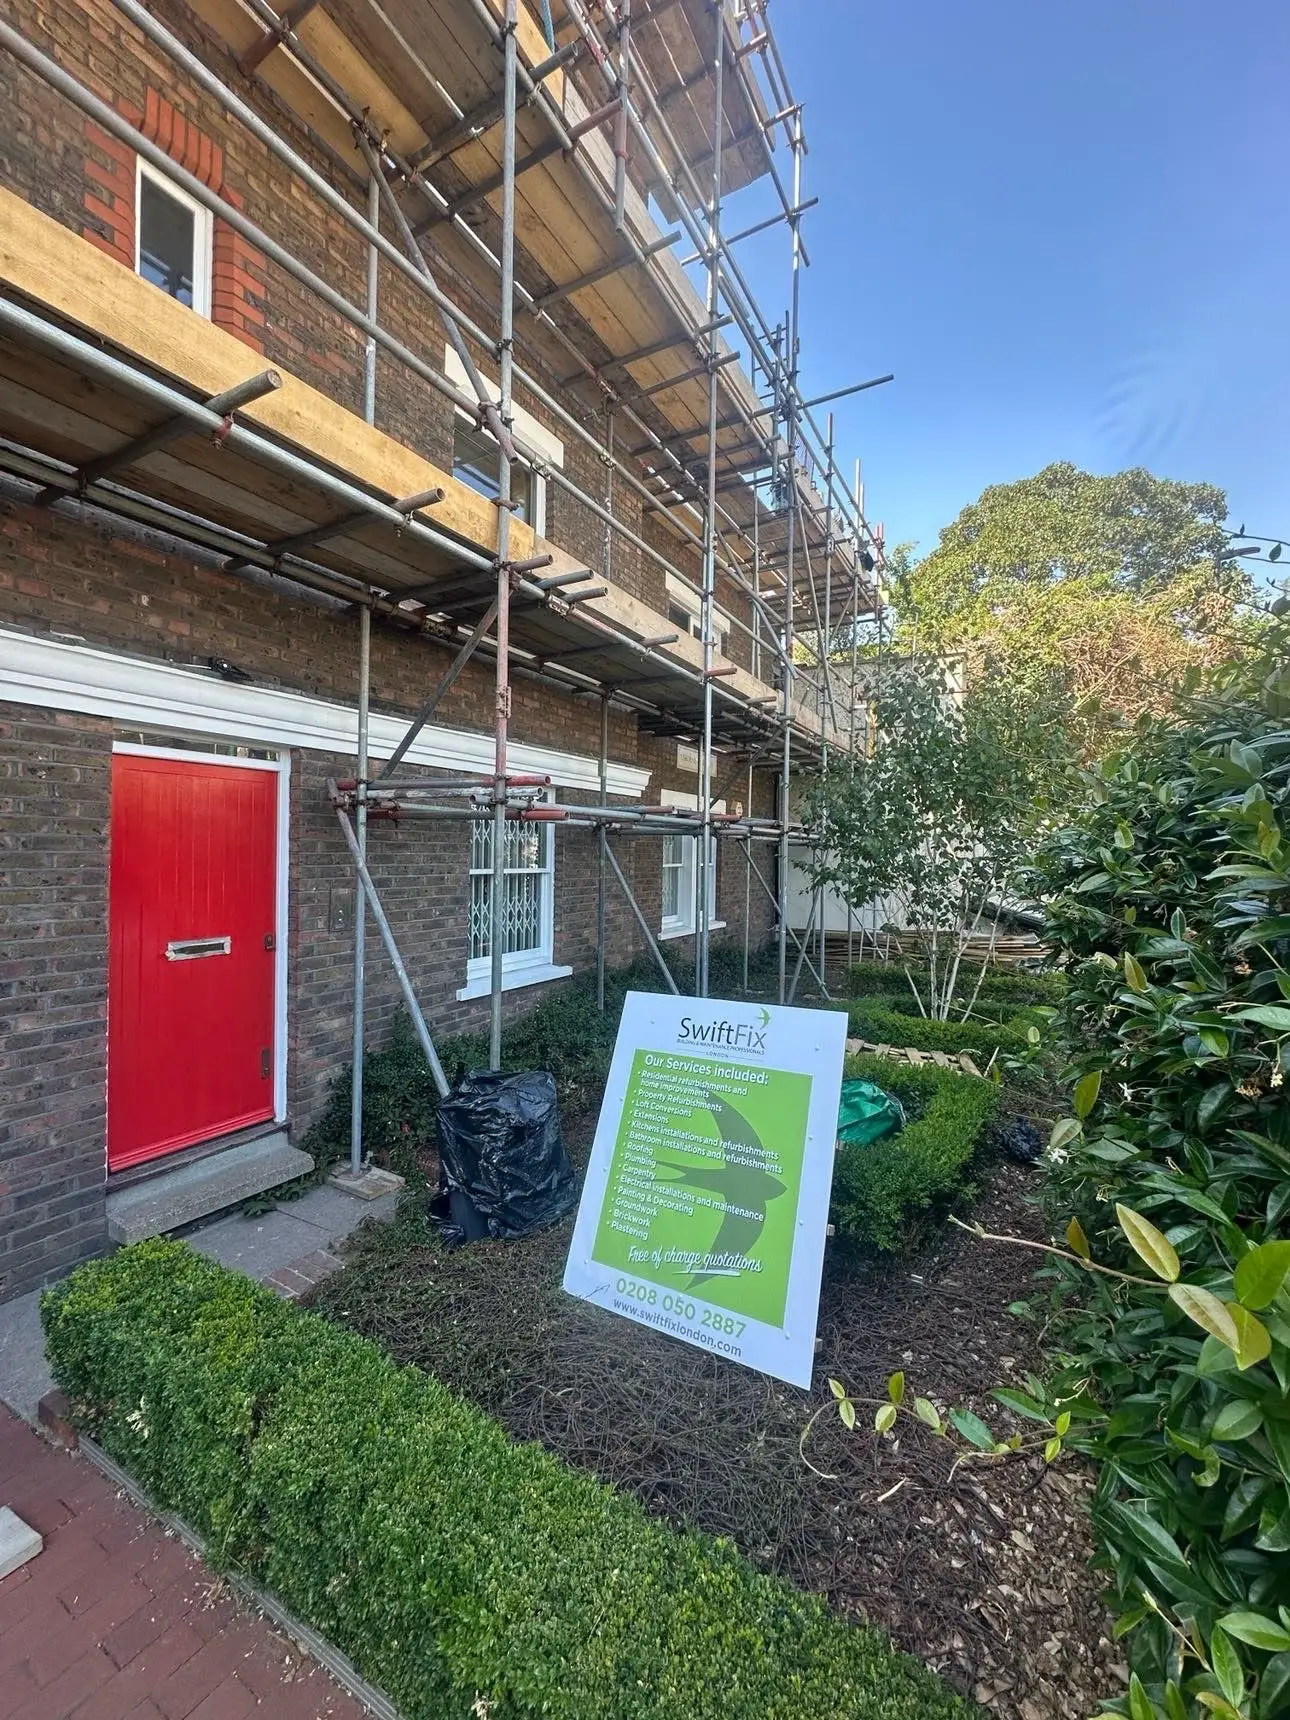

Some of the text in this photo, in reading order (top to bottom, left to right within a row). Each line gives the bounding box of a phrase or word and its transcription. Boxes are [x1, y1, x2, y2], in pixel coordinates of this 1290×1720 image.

[678, 1017, 767, 1049] SwiftFix
[645, 1054, 769, 1084] Our Services included:
[640, 1079, 710, 1099] home improvements
[641, 1070, 748, 1096] Residential refurbishments and
[636, 1099, 692, 1117] Loft Conversions
[638, 1089, 722, 1112] Property Refurbishments
[633, 1110, 669, 1124] Extensions
[627, 1141, 653, 1156] Roofing
[629, 1130, 783, 1174] Bathroom installations and refurbishments
[631, 1120, 779, 1160] Kitchens installations and refurbishments
[623, 1163, 657, 1180] Carpentry
[624, 1152, 657, 1168] Plumbing
[615, 1196, 658, 1216] Groundwork
[618, 1185, 694, 1216] Painting & Decorating
[620, 1174, 764, 1221] Electrical installations and maintenance
[613, 1208, 651, 1227] Brickwork
[611, 1220, 649, 1240] Plastering
[628, 1245, 763, 1273] Free of charge quotations
[615, 1278, 747, 1339] 0208 050 2887
[613, 1298, 742, 1358] www.swiftfixlondon.com
